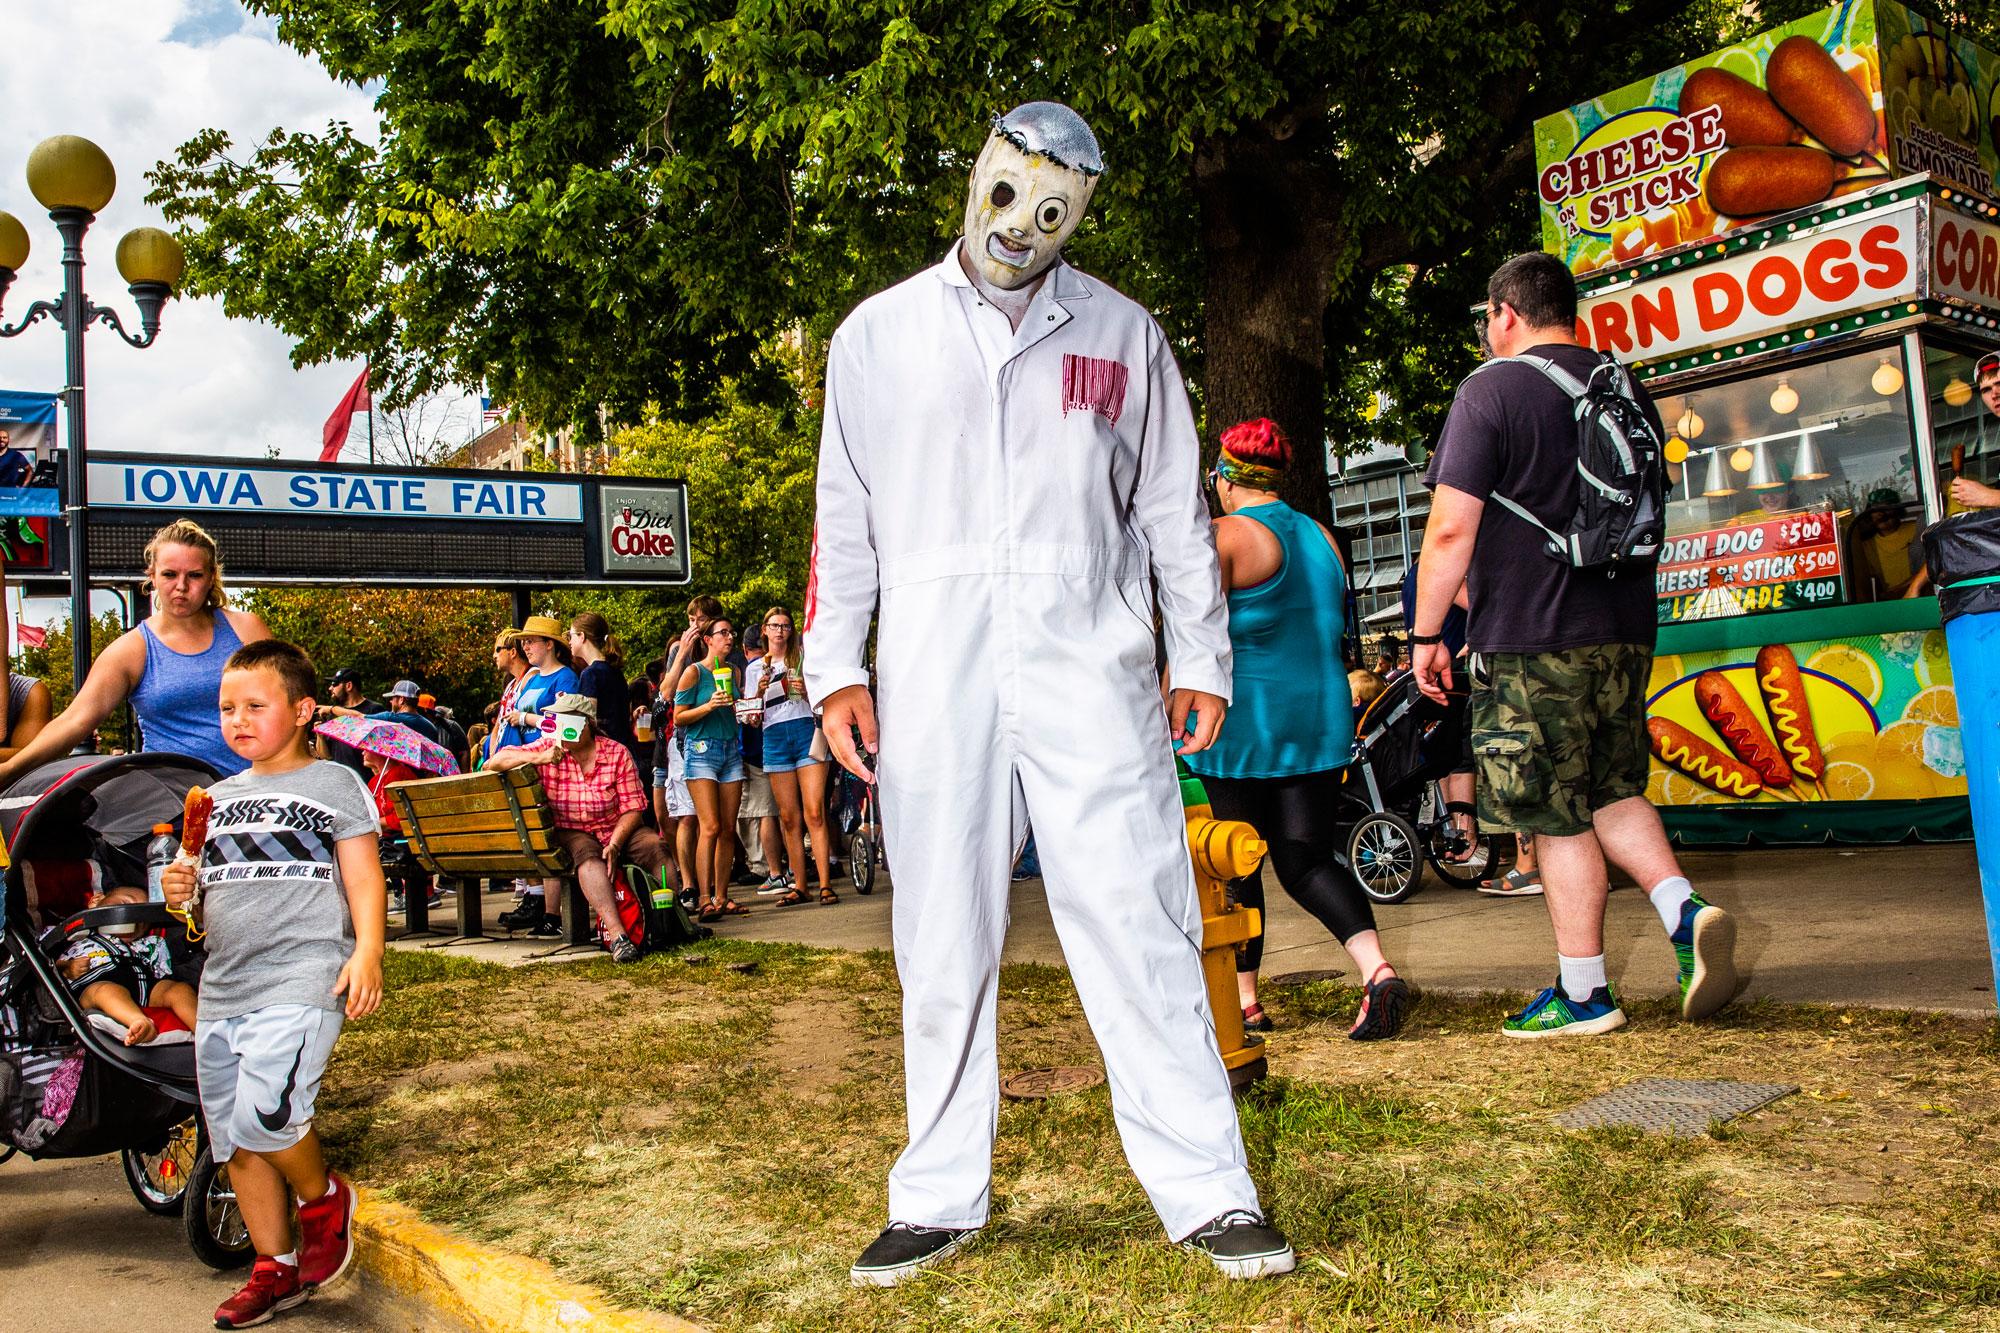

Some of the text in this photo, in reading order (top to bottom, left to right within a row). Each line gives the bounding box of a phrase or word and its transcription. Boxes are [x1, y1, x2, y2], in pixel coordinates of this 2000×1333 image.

[1539, 104, 1725, 204] CHEESE
[1910, 121, 1979, 162] Fresh Squeezed
[1896, 136, 1991, 192] LEMONADE
[1589, 164, 1700, 227] STICK
[1559, 206, 1576, 225] ON
[1569, 221, 1579, 236] A
[1936, 221, 2000, 299] COR
[1575, 224, 1909, 353] RN DOGS
[124, 467, 546, 516] IOWA STATE FAIR
[630, 508, 673, 529] Diet
[611, 525, 675, 557] Coke
[1659, 535, 1708, 564] ORN
[1715, 528, 1764, 556] DOG
[1656, 563, 1739, 594] HEESE ON
[1723, 574, 1735, 583] A
[1741, 554, 1798, 583] STICK
[1672, 584, 1786, 619] LENADE
[274, 801, 335, 832] NIK
[207, 868, 225, 882] NIKE
[226, 866, 252, 879] NIKE
[253, 865, 283, 878] NIKE
[283, 864, 310, 877] NIKE
[312, 866, 332, 880] NIKE
